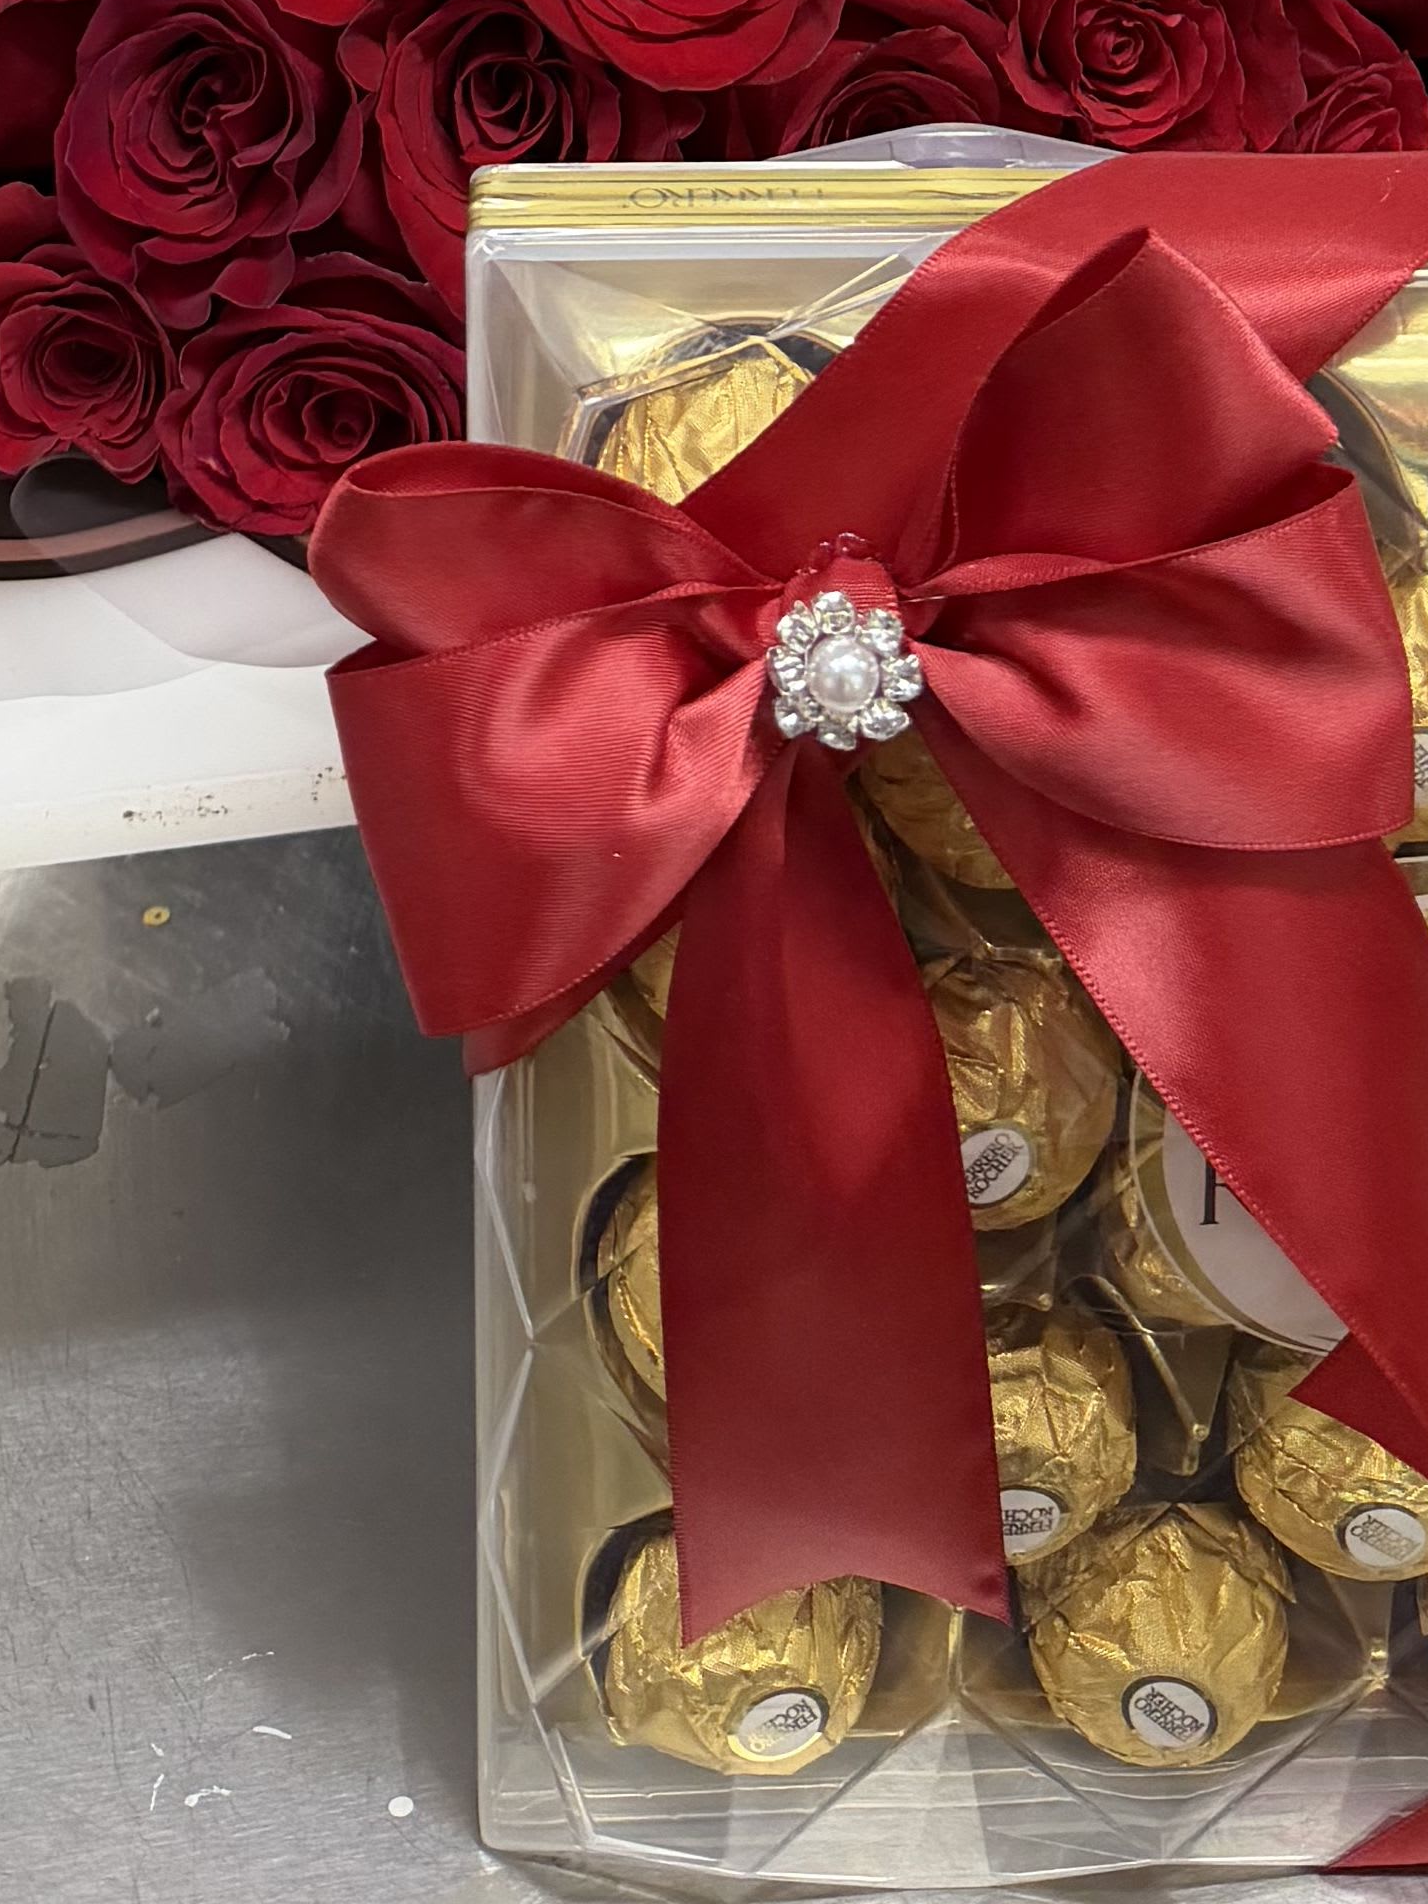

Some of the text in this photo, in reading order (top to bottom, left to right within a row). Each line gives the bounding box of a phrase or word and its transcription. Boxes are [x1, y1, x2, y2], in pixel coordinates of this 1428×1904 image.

[958, 1132, 1010, 1192] ERRERO
[1001, 1504, 1054, 1523] ROCH
[1001, 1518, 1054, 1536] FERRE
[1132, 1695, 1195, 1741] FERRERO
[1141, 1685, 1206, 1733] ROCHER
